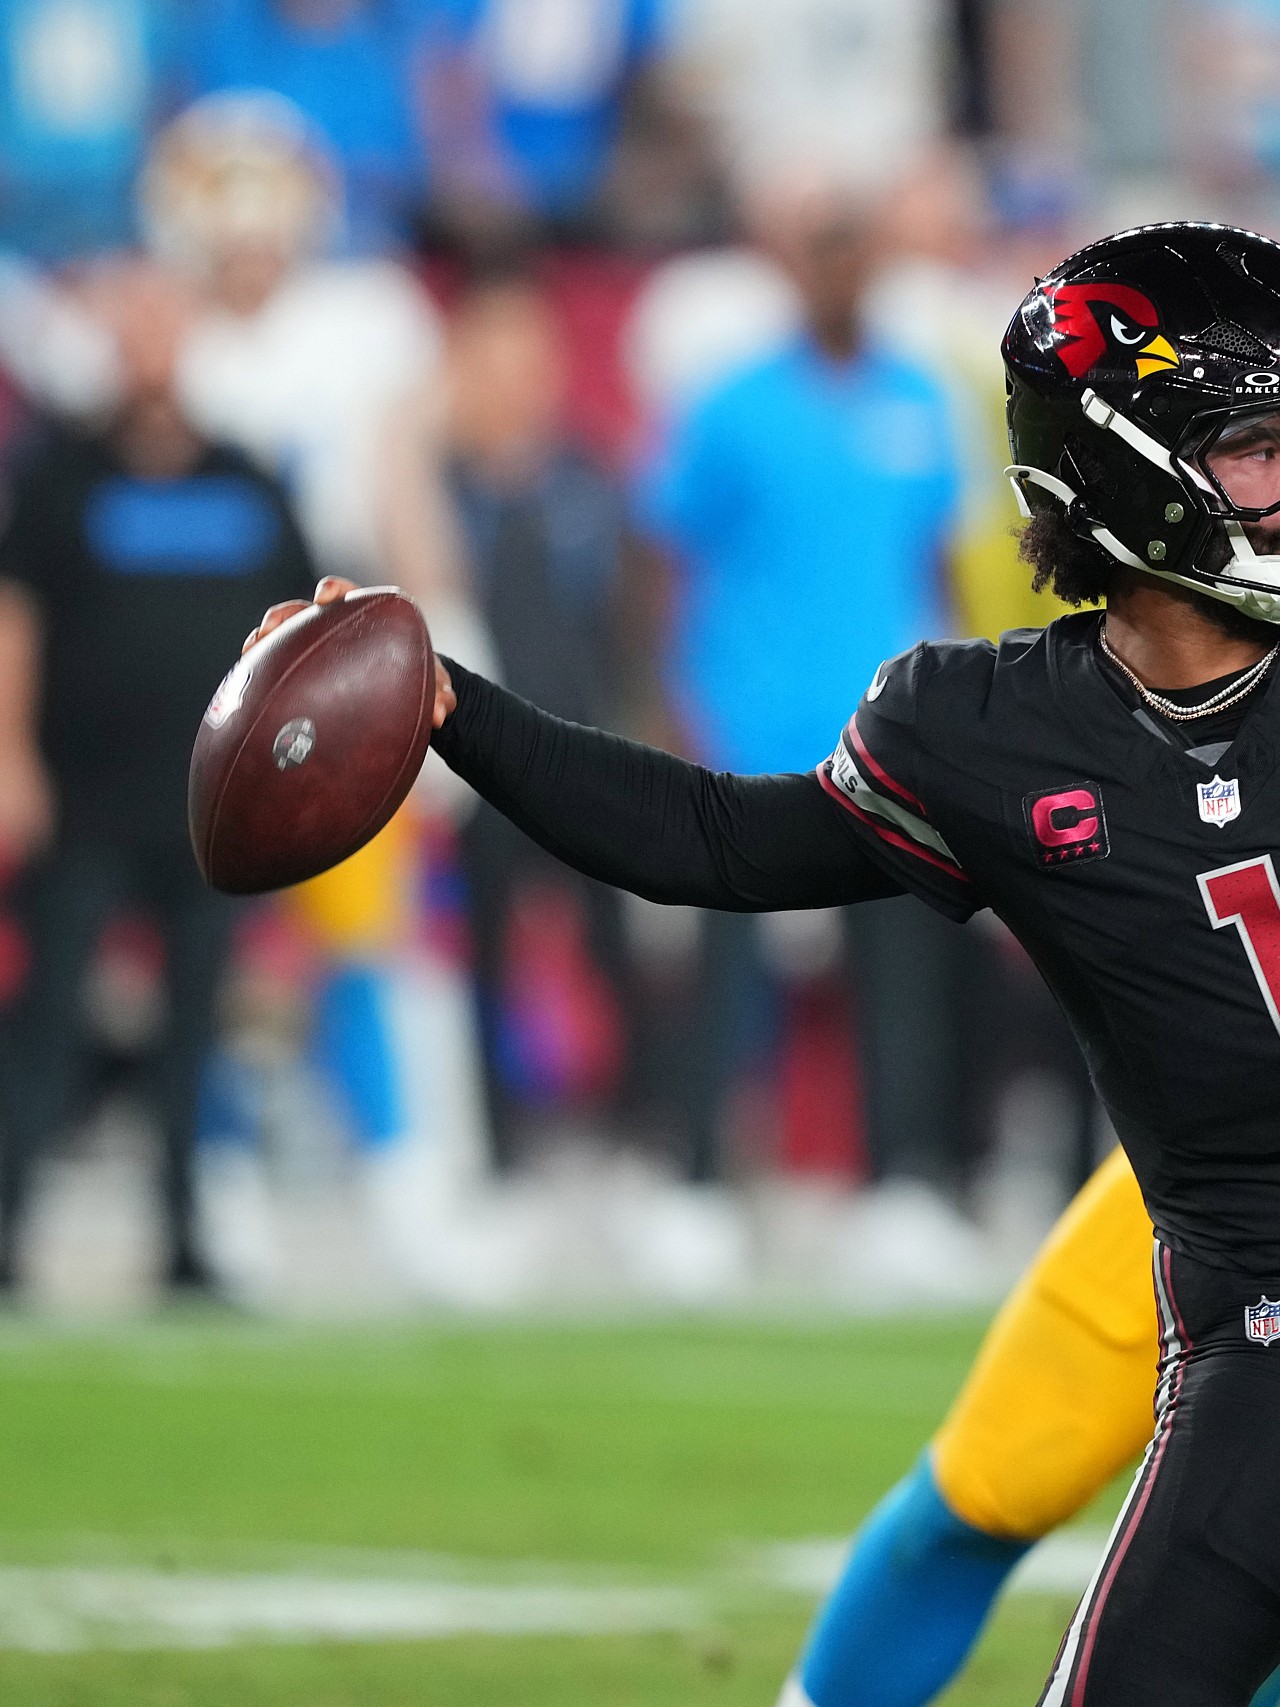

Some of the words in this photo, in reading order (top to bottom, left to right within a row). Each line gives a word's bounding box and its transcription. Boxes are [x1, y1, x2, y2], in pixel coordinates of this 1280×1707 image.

[1205, 798, 1233, 816] NFL
[1032, 789, 1099, 847] C
[1252, 1318, 1279, 1336] NFL
